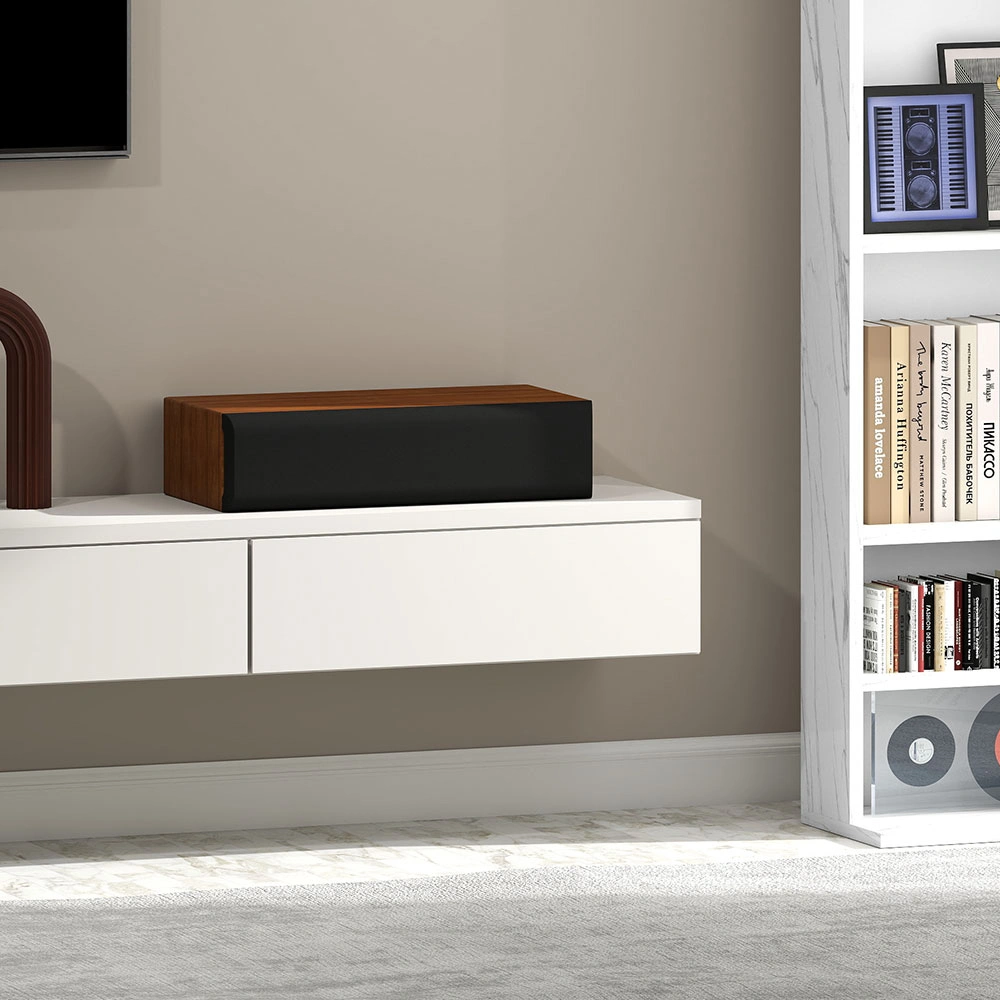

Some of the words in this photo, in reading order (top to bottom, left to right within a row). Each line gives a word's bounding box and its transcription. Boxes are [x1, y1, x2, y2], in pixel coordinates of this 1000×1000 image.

[941, 342, 952, 372] Karen
[874, 377, 886, 426] amanda
[896, 362, 907, 413] Arianna
[939, 376, 952, 431] McCartney
[874, 429, 886, 479] lovelace
[894, 419, 907, 491] Huffington
[984, 422, 995, 479] ПИКАССО
